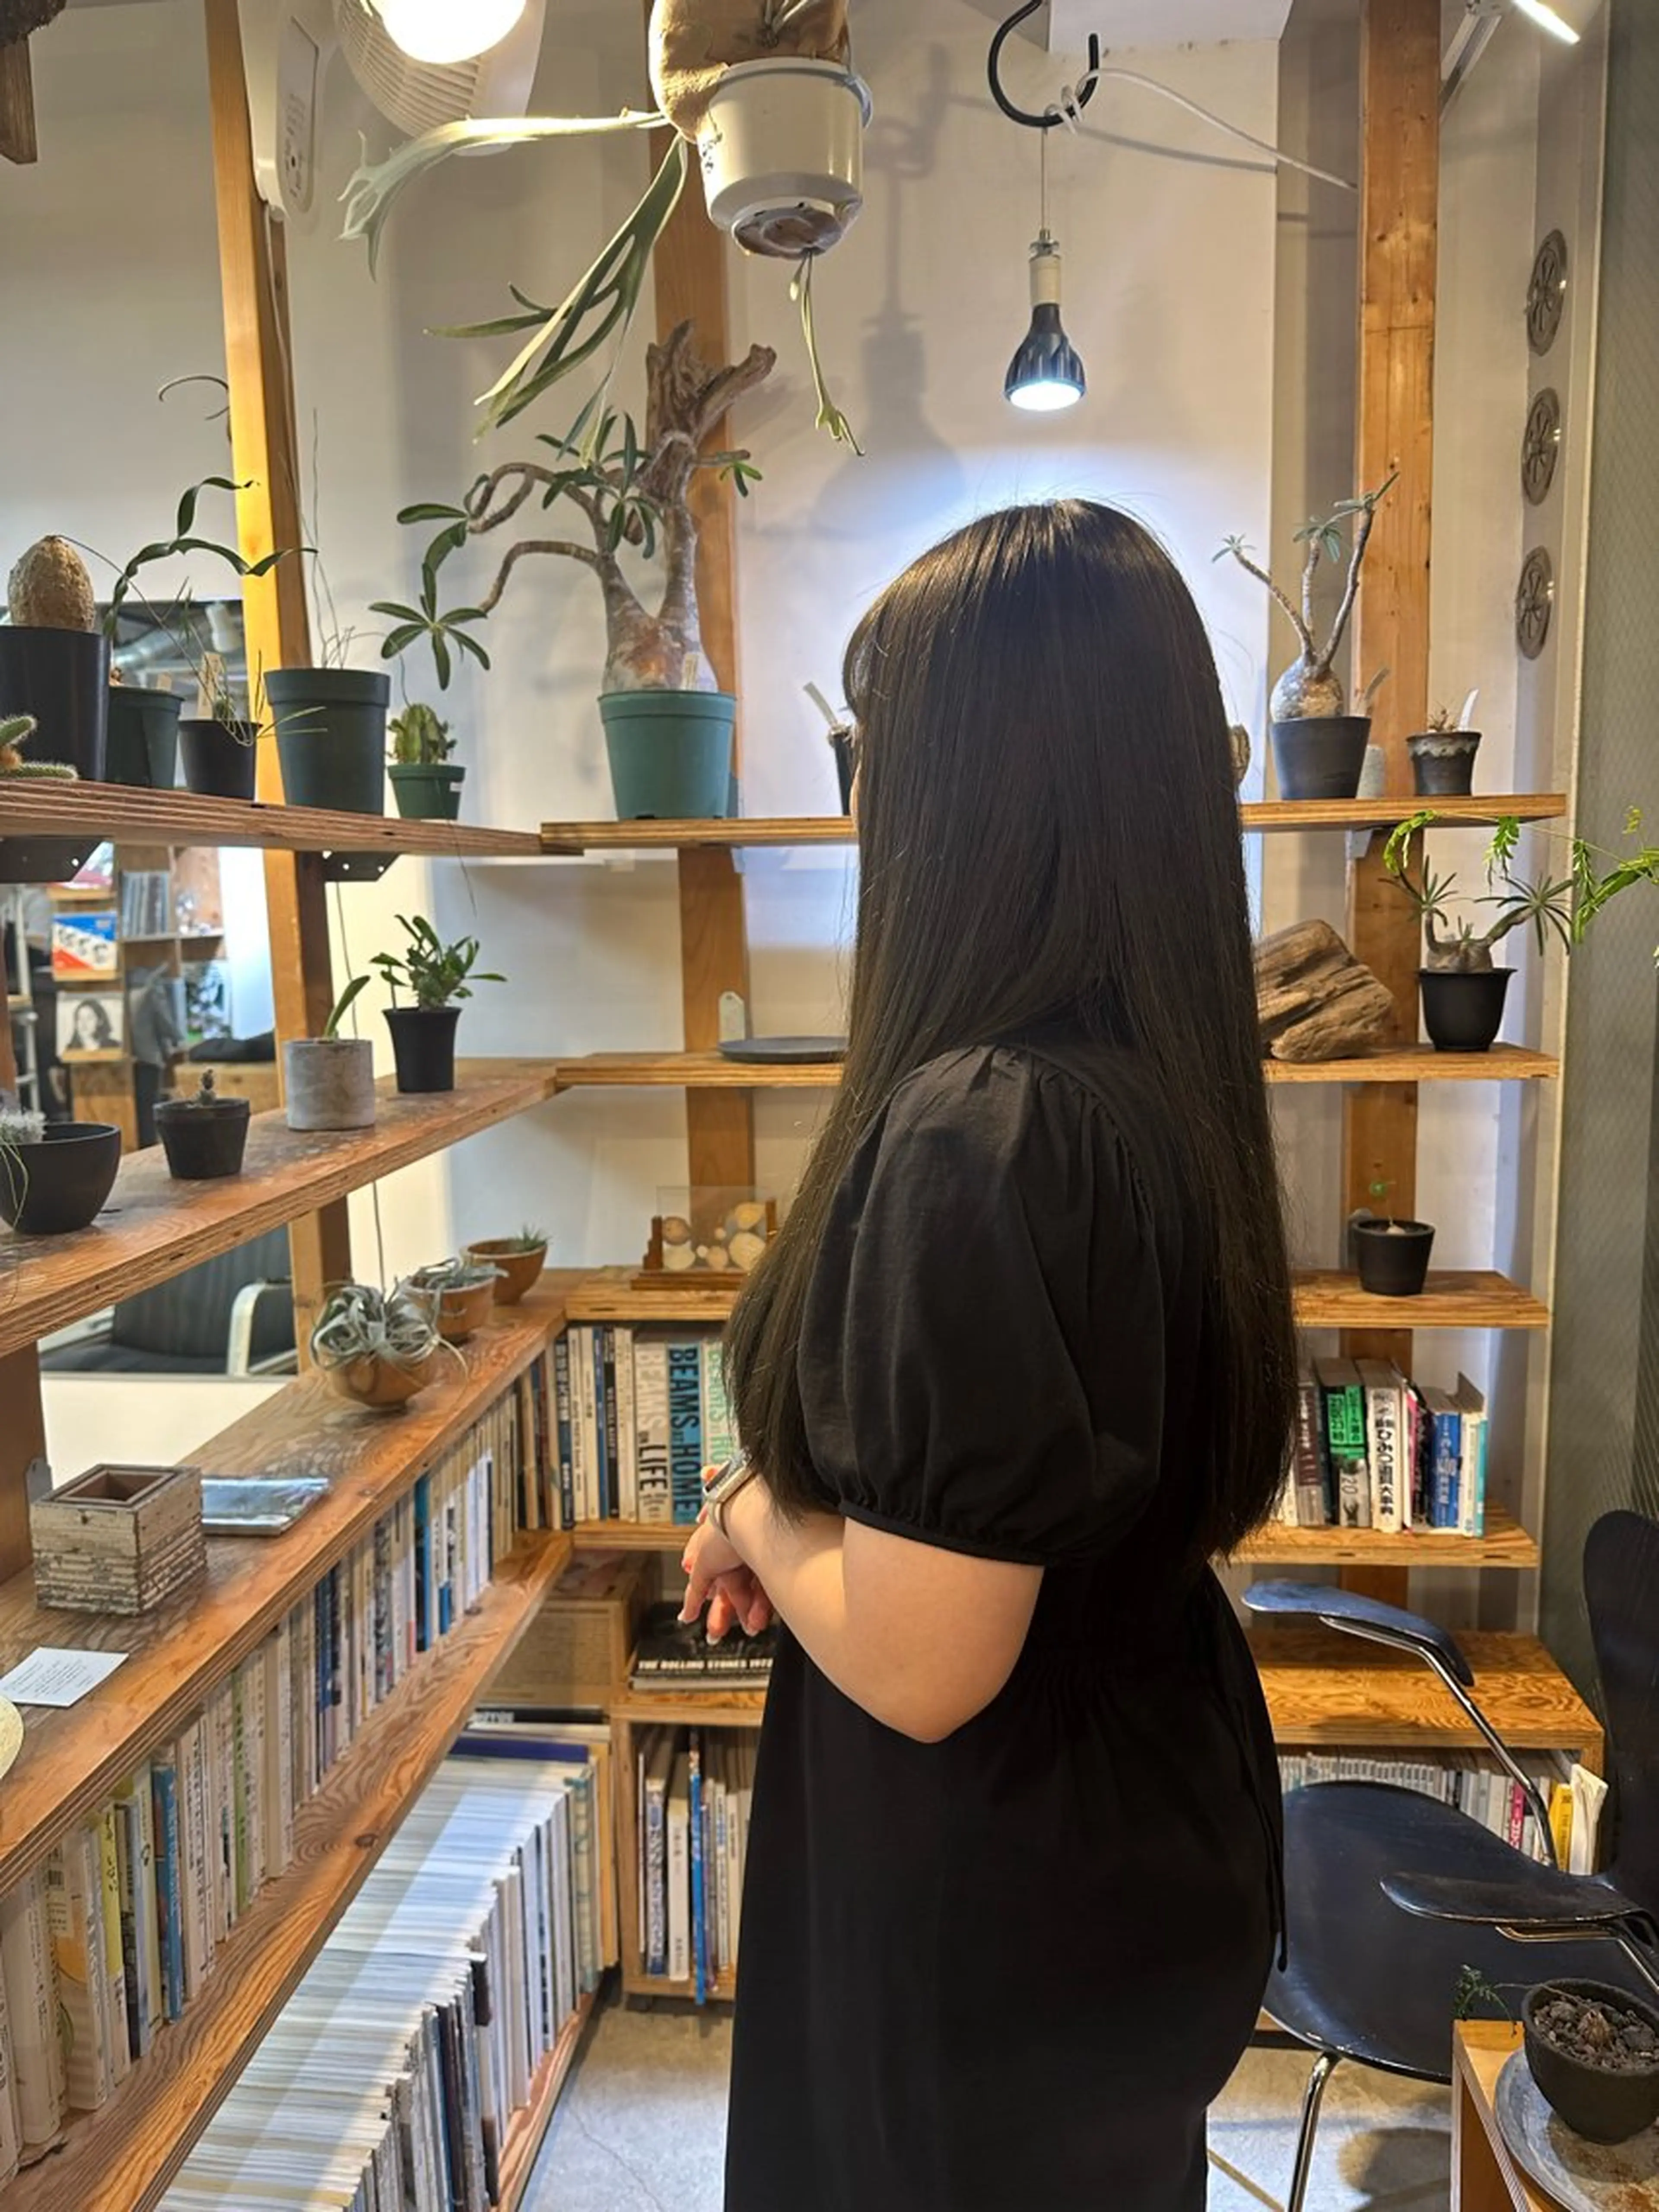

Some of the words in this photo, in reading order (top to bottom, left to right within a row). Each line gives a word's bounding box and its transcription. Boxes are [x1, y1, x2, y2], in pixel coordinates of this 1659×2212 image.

[637, 1351, 667, 1429] BEAMS
[669, 1348, 699, 1429] BEAMS
[638, 1444, 668, 1491] LIFE
[672, 1443, 702, 1512] HOME
[1341, 1475, 1358, 1494] 20
